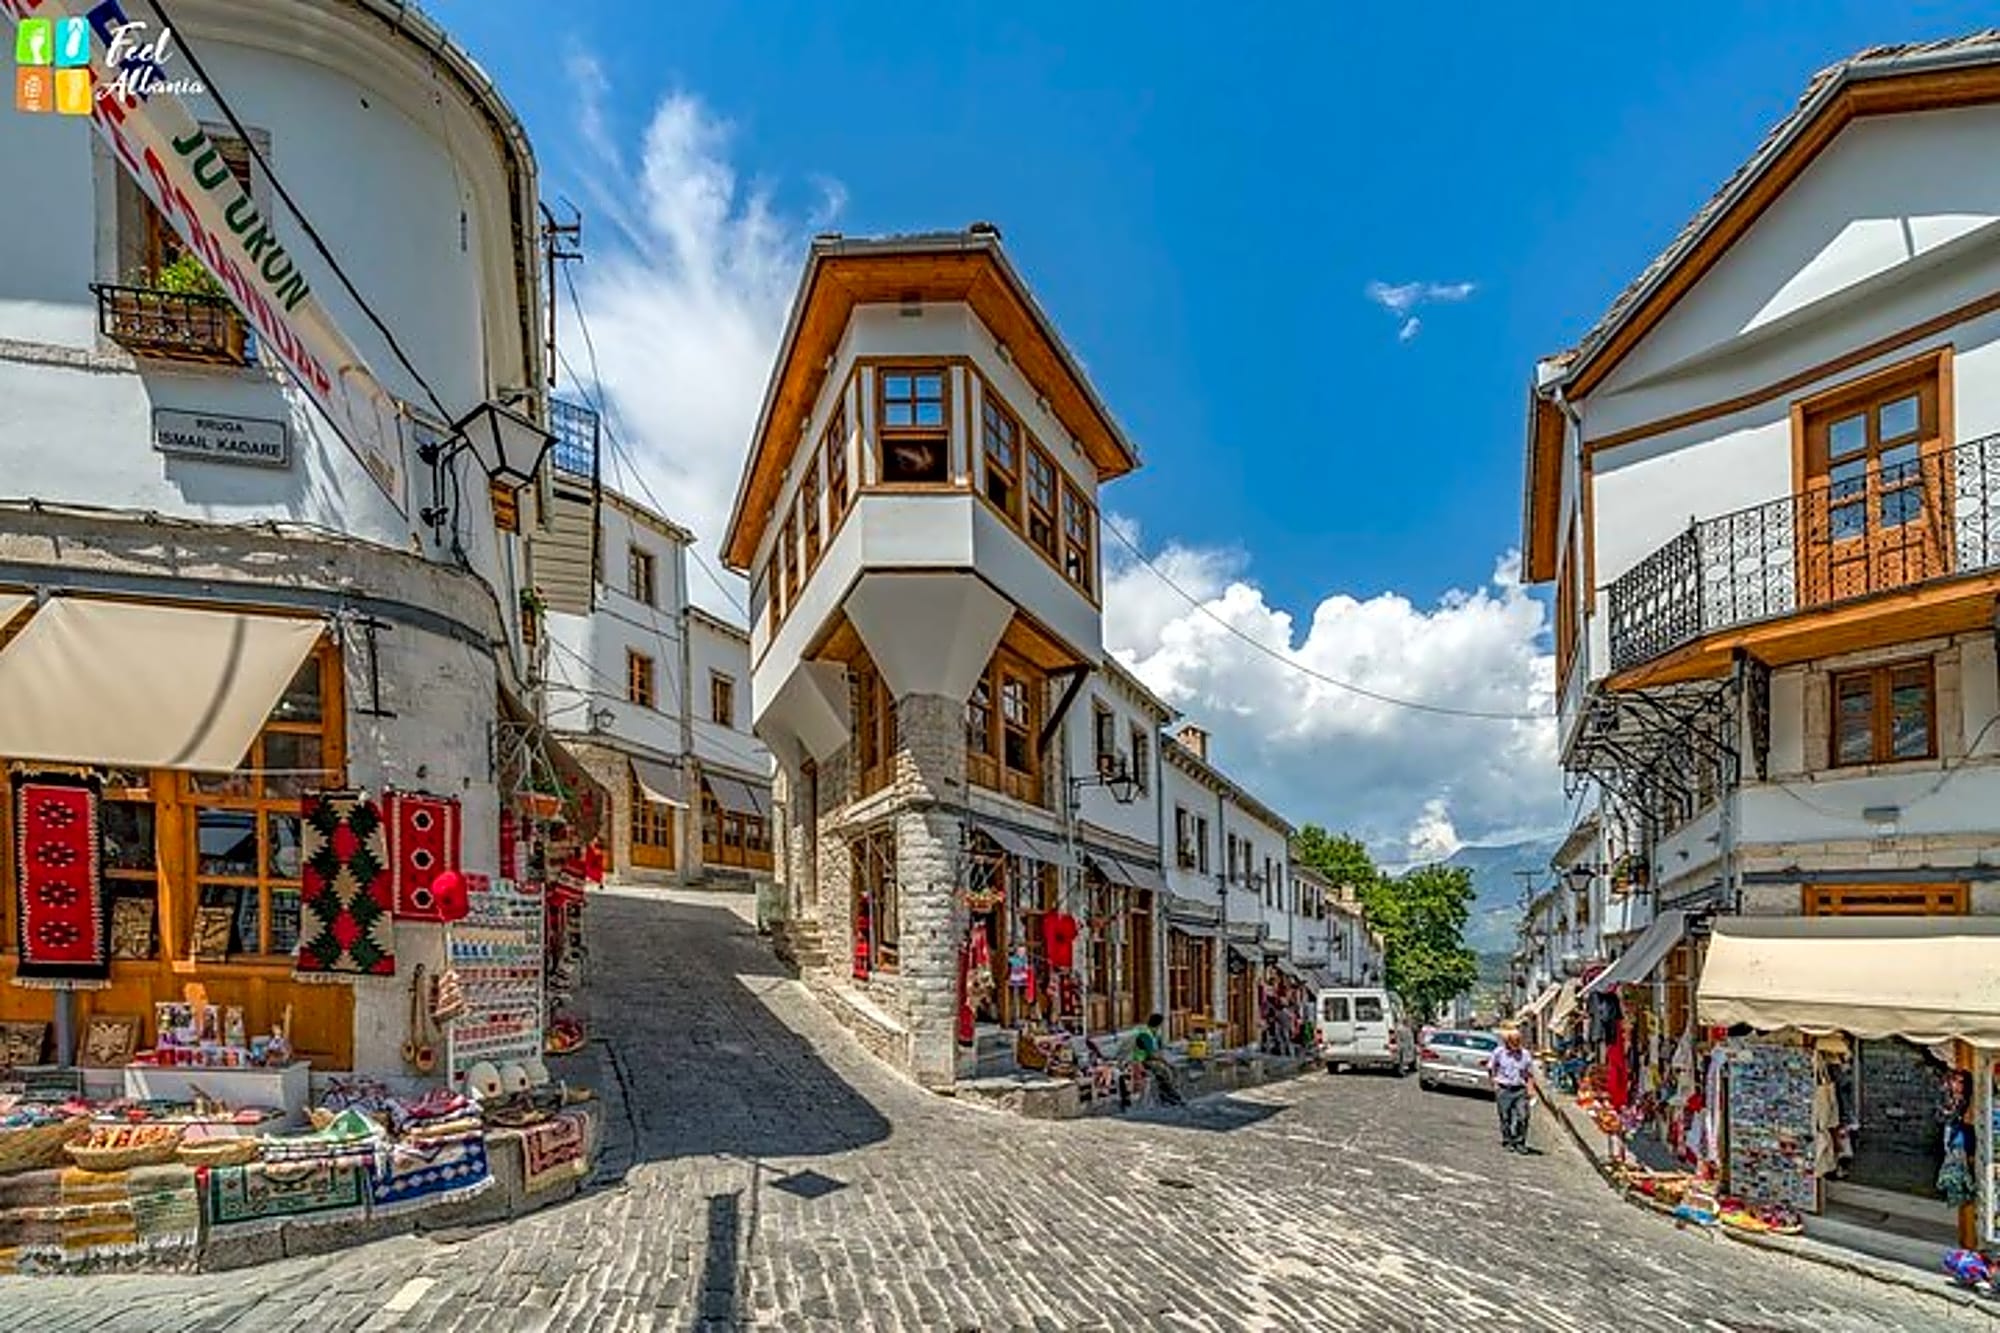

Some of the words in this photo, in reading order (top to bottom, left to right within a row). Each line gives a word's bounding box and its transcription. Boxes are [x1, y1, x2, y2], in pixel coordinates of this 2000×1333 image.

[172, 127, 230, 190] JU
[196, 419, 245, 433] RRUGA
[158, 430, 212, 450] ISMAIL
[216, 438, 281, 458] KADARE
